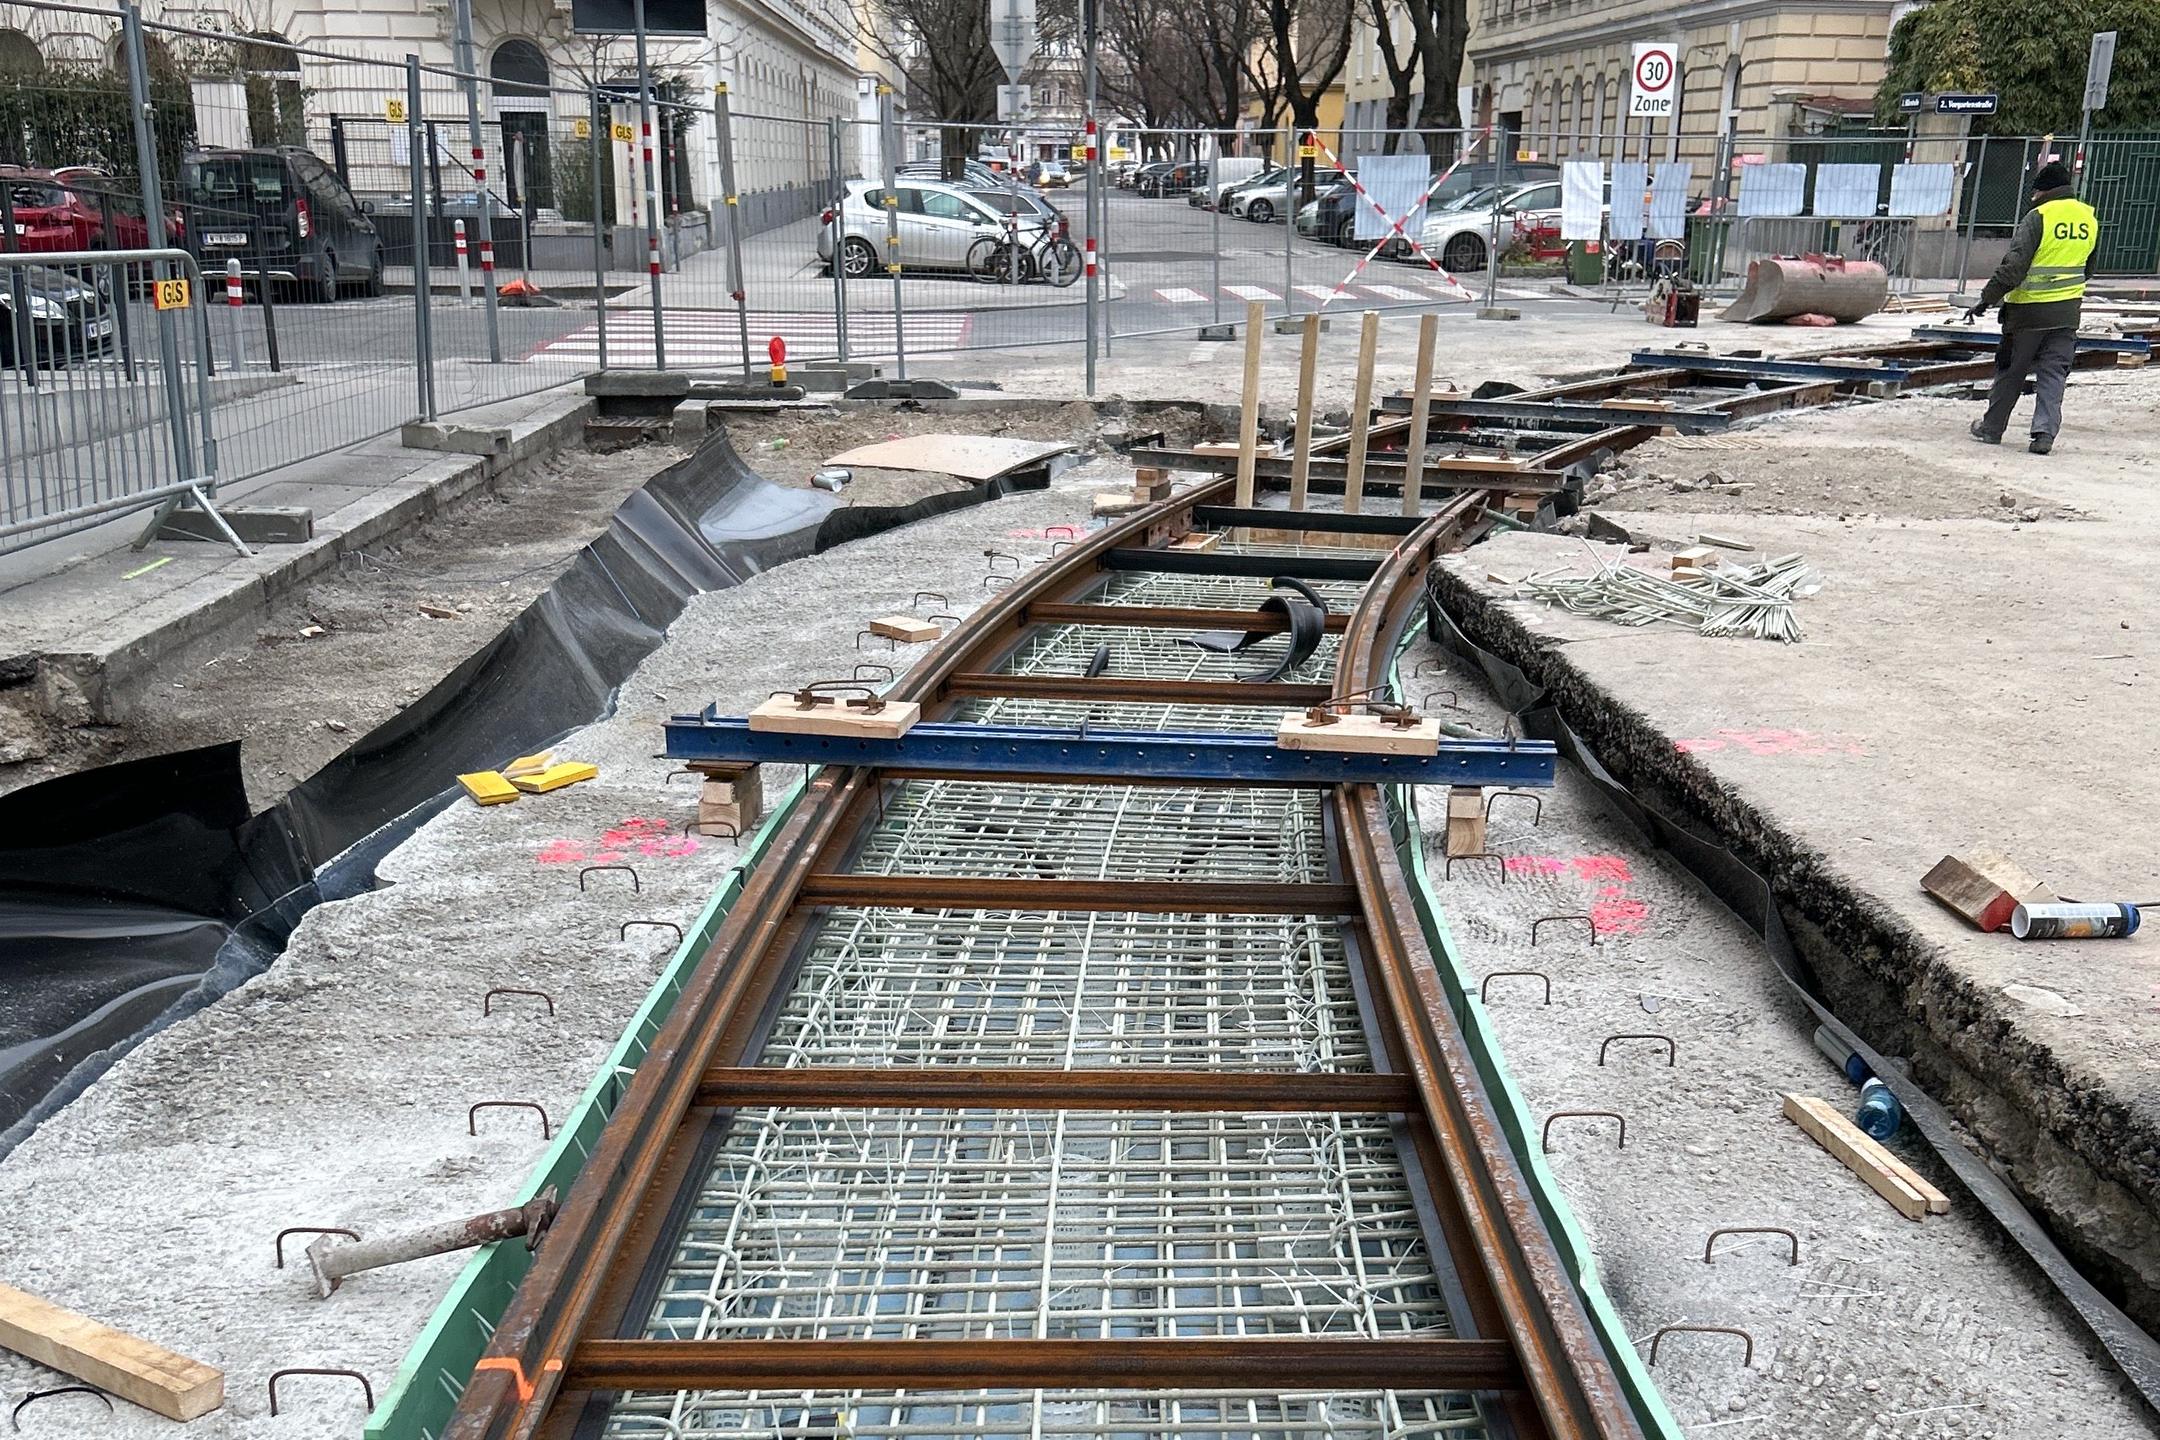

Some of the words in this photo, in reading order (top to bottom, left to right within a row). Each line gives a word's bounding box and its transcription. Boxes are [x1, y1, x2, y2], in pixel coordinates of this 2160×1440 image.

[1644, 61, 1664, 81] 30
[389, 101, 403, 119] GLS
[1635, 95, 1669, 112] Zone
[1940, 100, 1947, 108] 2.
[615, 124, 633, 140] GLS
[2054, 222, 2089, 240] GLS
[163, 281, 184, 304] GLS
